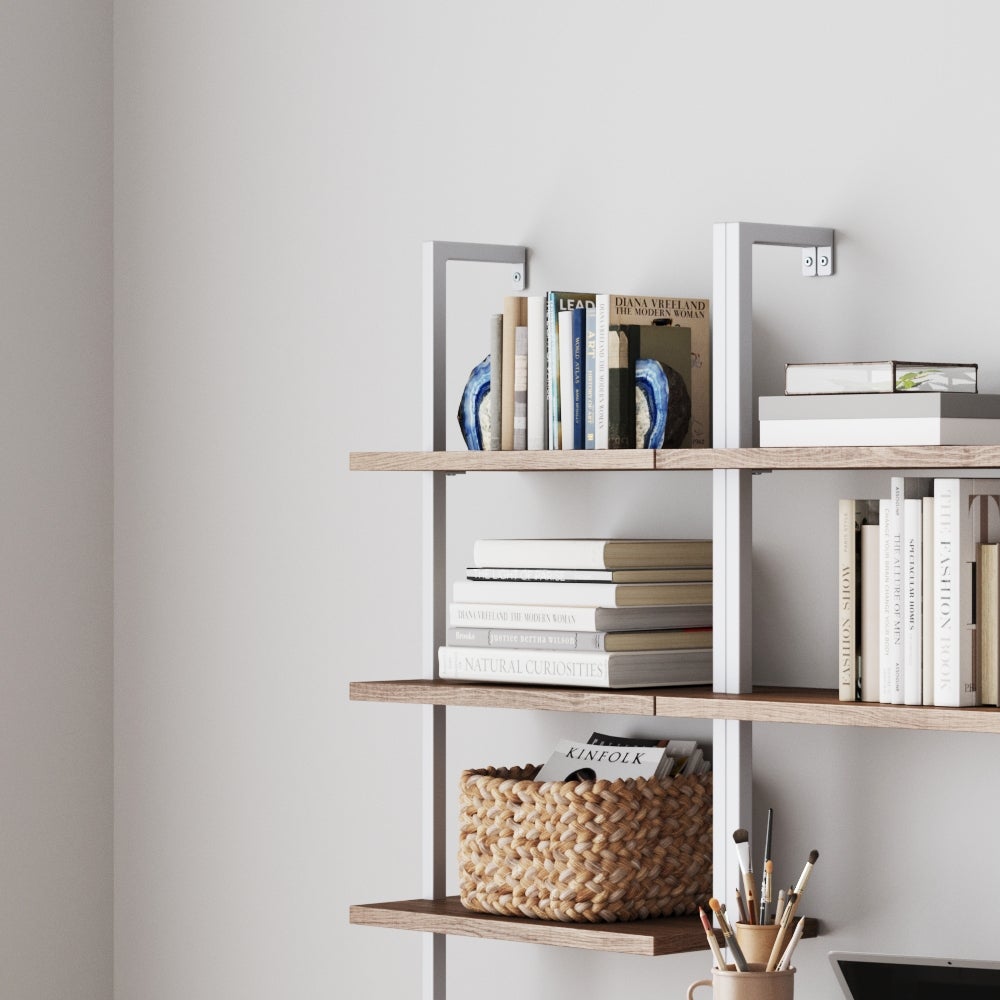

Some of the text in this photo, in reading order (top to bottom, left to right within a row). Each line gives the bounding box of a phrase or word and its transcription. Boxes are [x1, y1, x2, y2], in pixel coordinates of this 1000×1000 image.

[615, 296, 706, 311] DIANA VREELAND
[615, 306, 705, 319] THE MODERN WOMAN
[587, 332, 596, 358] ART
[893, 535, 901, 645] THE ALLURE OF MEN
[940, 489, 952, 690] THE FASHION BOOK
[511, 611, 521, 622] THE
[524, 611, 551, 623] MODERN
[553, 613, 576, 624] WOMAN
[842, 565, 851, 686] FASHION SHOW
[465, 657, 523, 674] NATURAL
[526, 660, 603, 678] CURIOSITIES
[565, 747, 646, 765] KINFOLK
